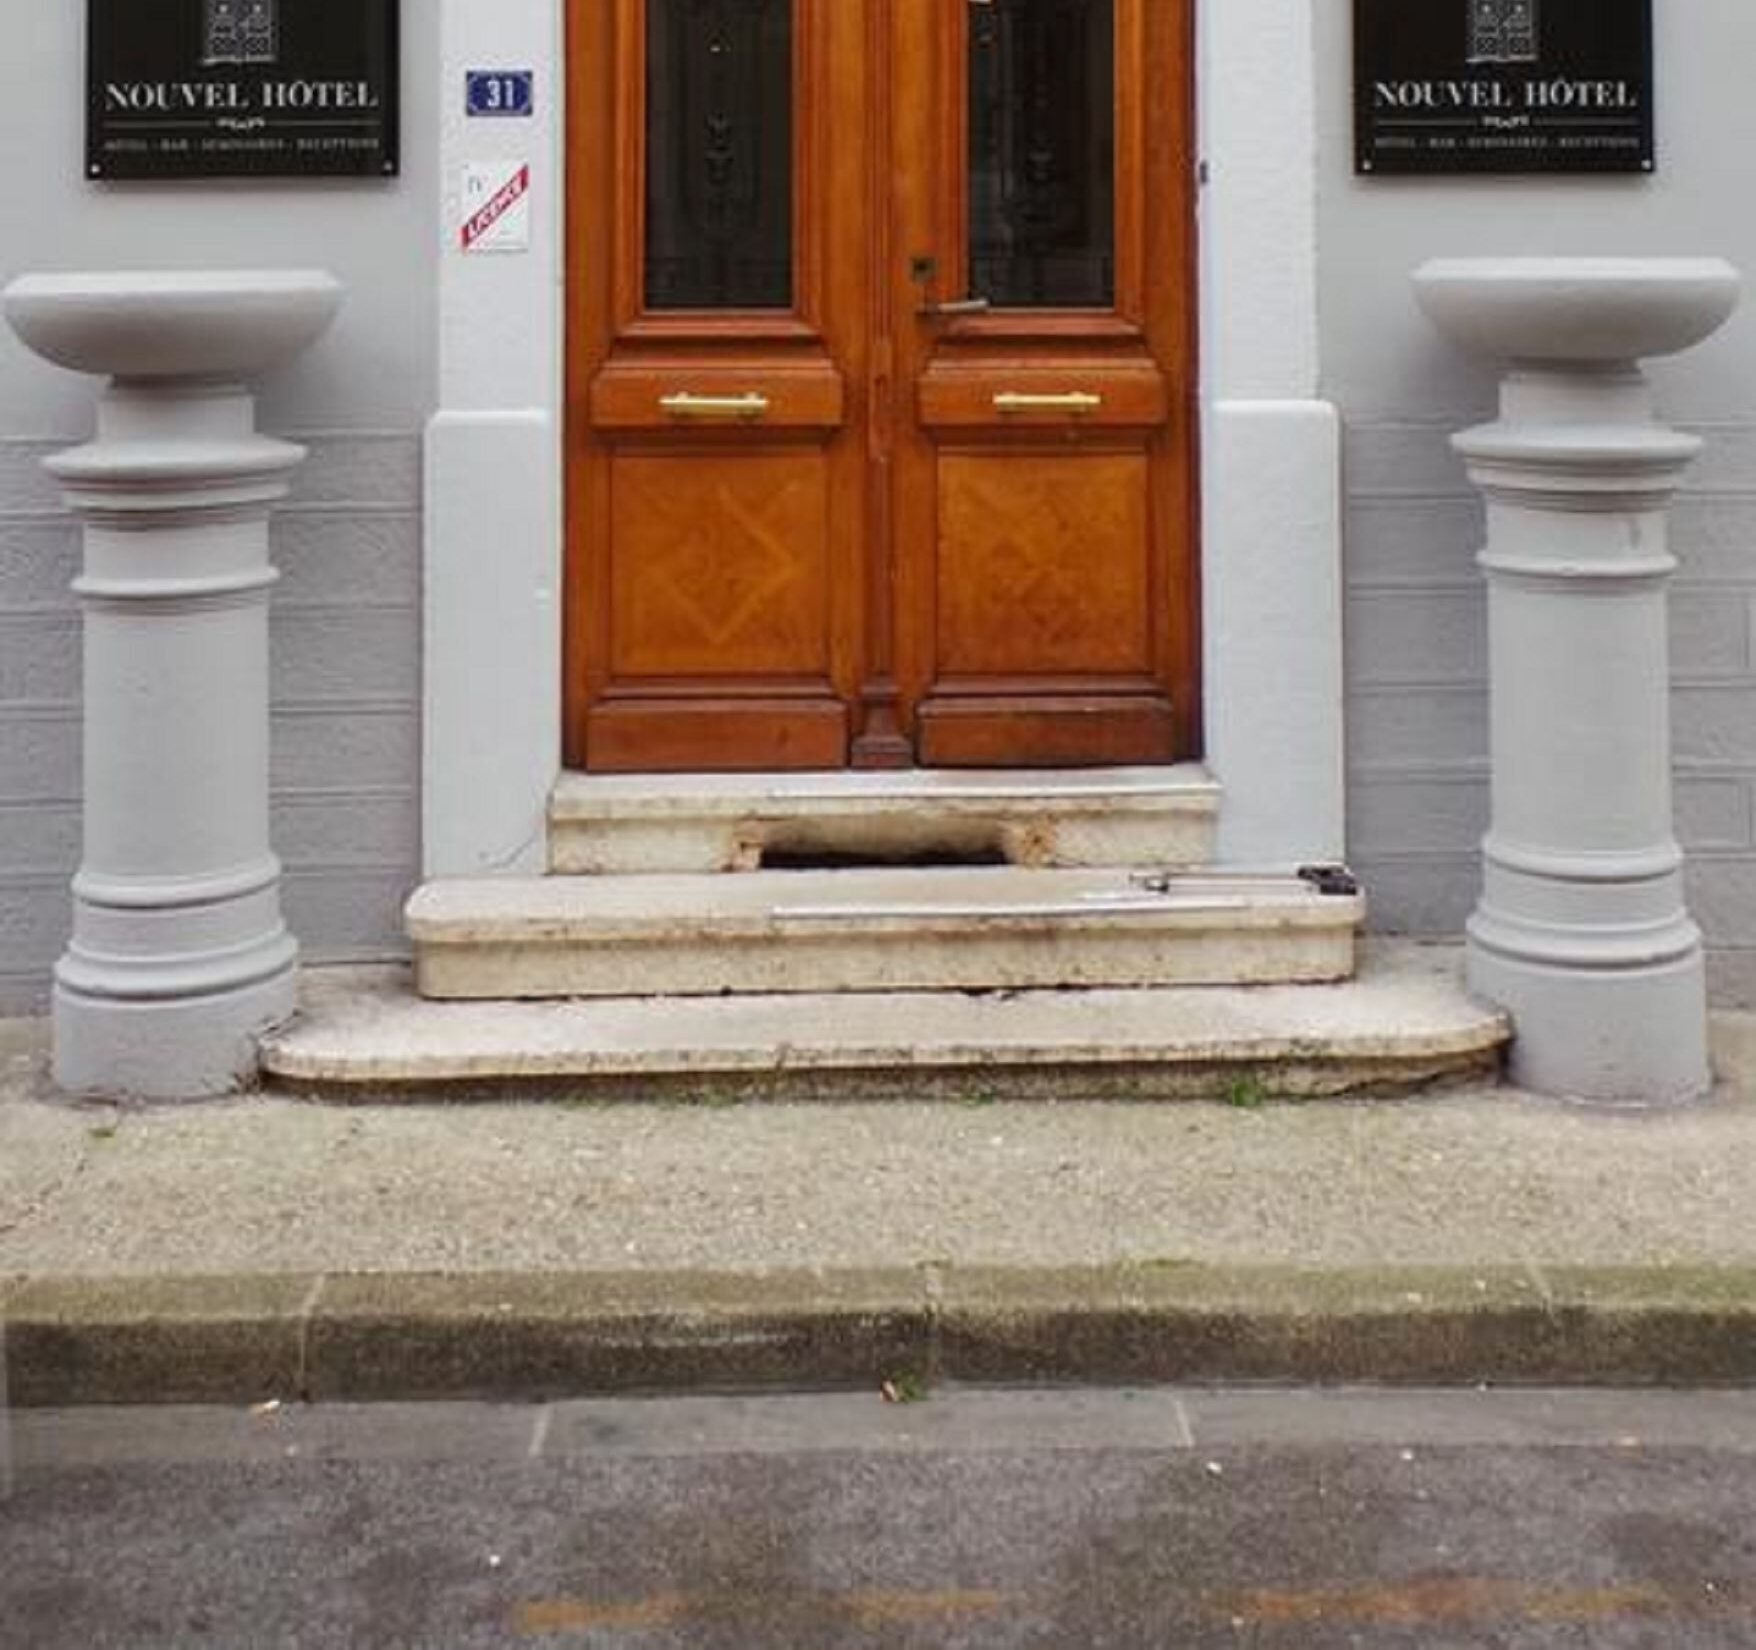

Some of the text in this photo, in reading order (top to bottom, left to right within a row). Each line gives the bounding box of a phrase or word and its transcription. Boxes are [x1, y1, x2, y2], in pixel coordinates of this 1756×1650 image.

[105, 79, 379, 110] NOUVEL HÔTEL
[486, 79, 515, 108] 31
[1375, 76, 1638, 108] NOUVEL HÔTEL
